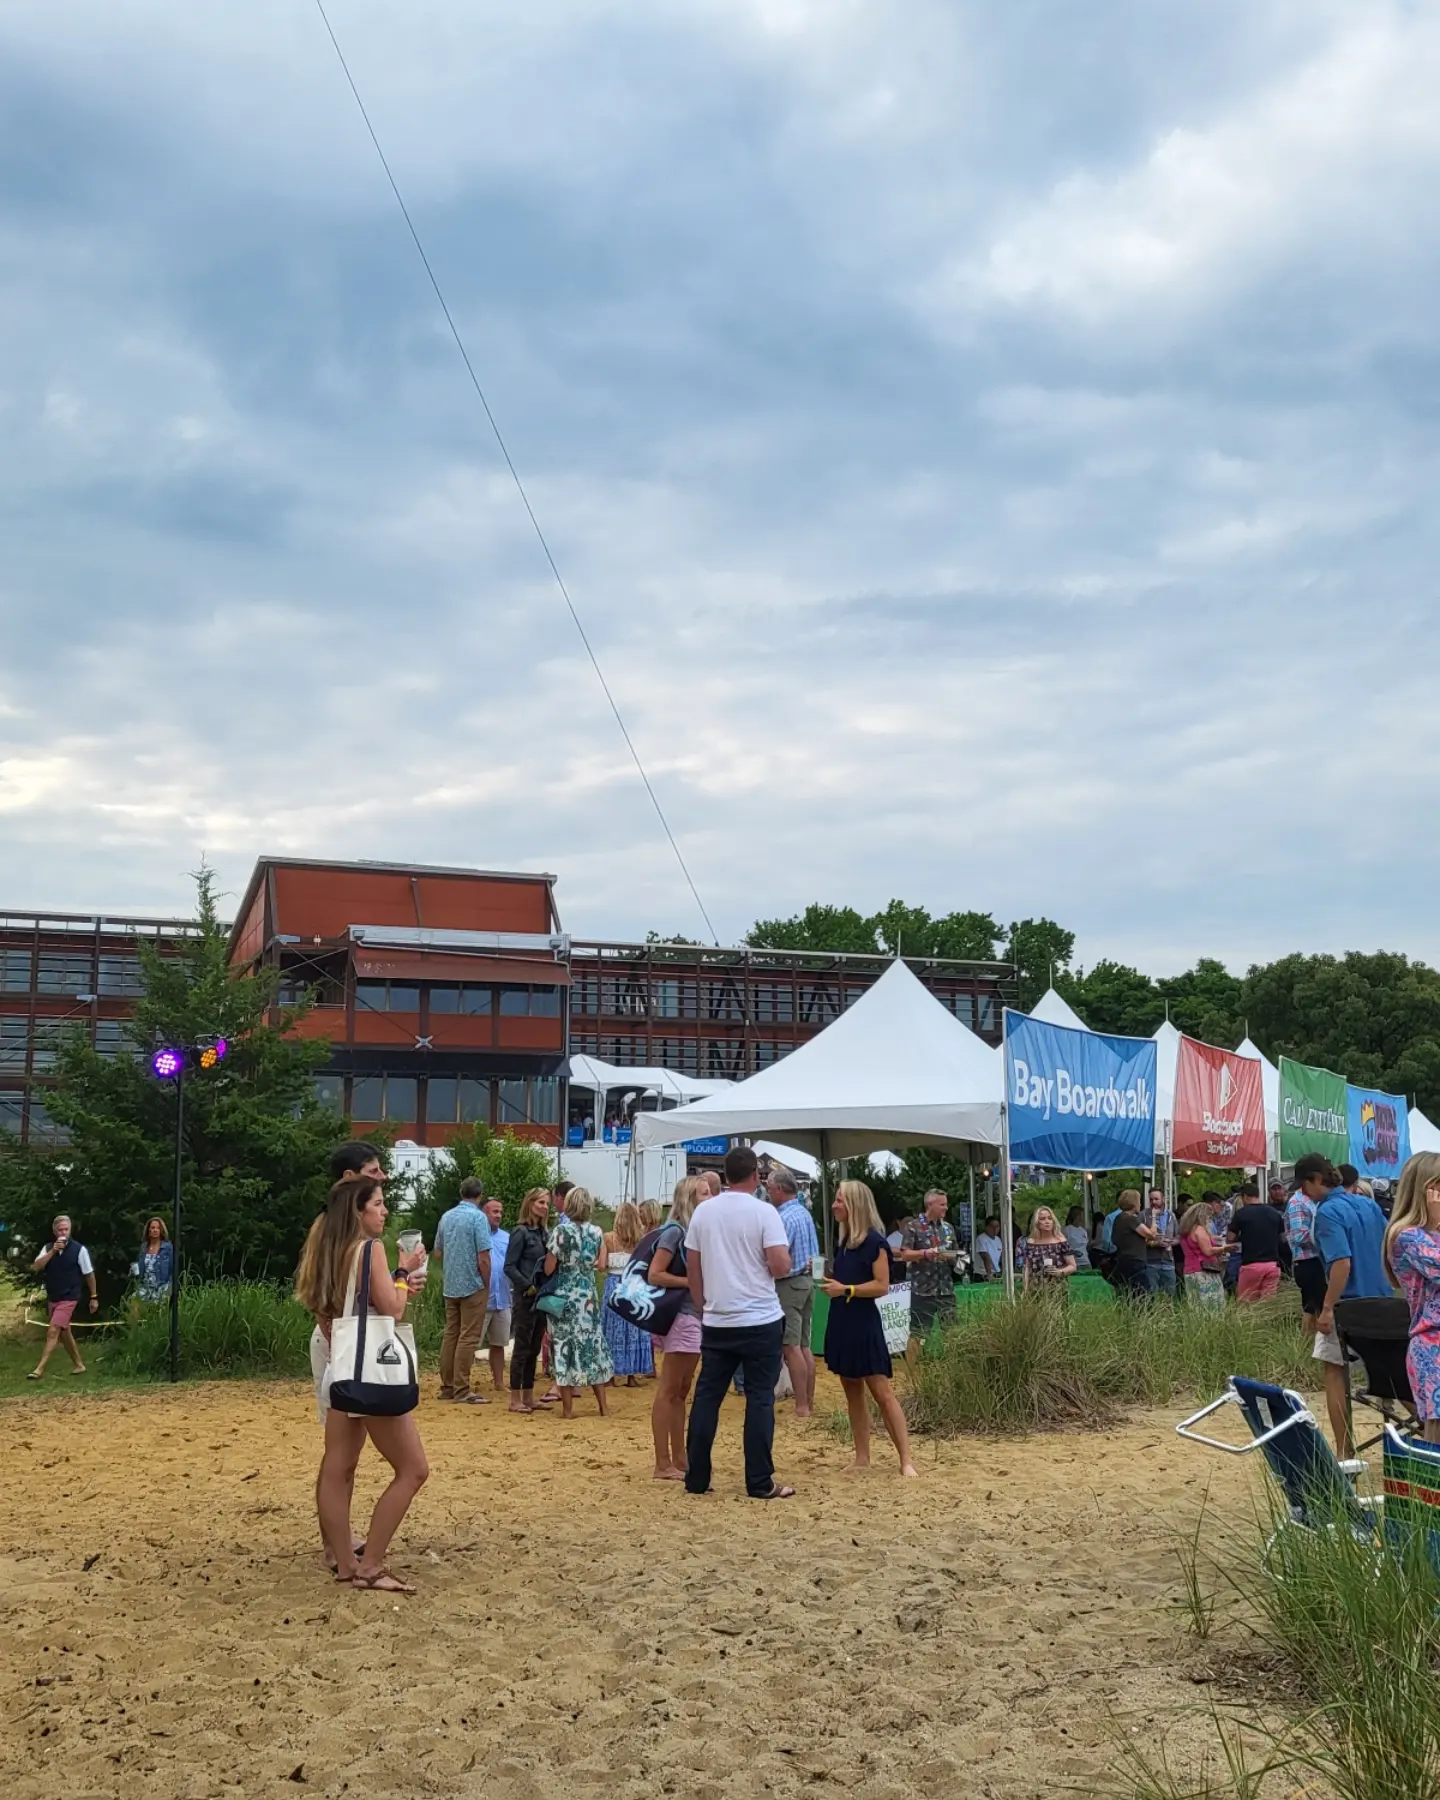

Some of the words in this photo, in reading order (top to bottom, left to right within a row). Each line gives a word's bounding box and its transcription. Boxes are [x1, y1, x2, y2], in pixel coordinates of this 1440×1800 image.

[1013, 1059, 1054, 1121] Bay
[1056, 1068, 1150, 1120] Boardwalk
[692, 1144, 724, 1153] LOUNGE
[880, 1302, 900, 1313] HELP
